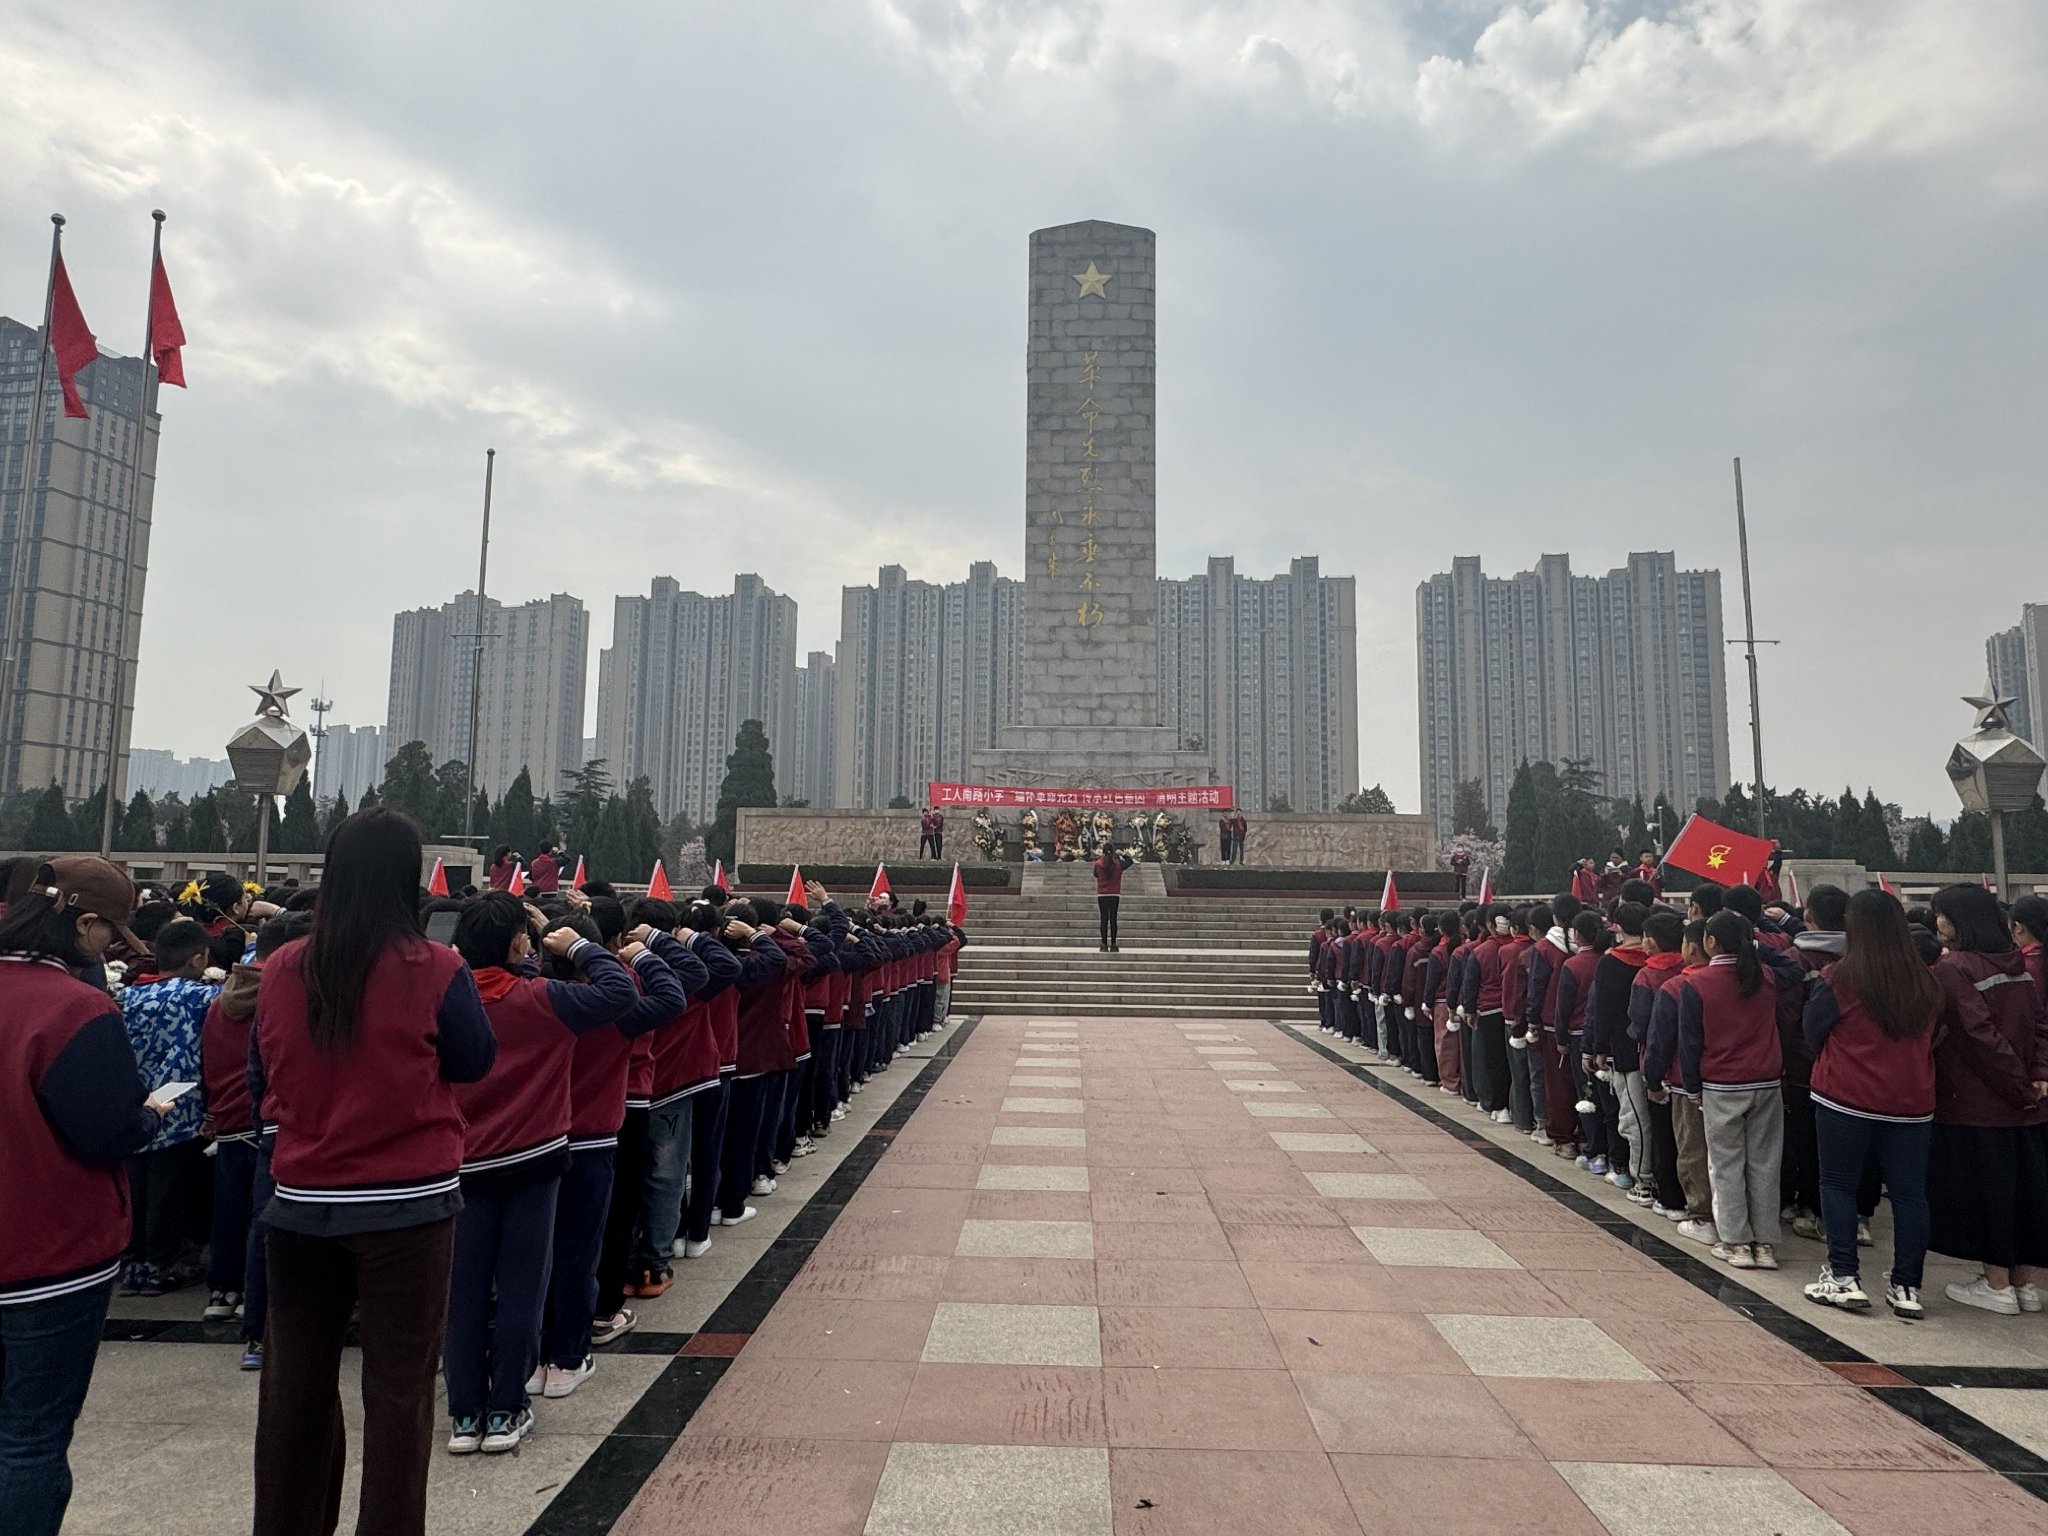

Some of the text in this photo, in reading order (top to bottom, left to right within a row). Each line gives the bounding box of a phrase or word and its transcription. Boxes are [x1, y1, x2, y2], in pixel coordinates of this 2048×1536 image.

[941, 787, 1004, 802] 工人南路小学
